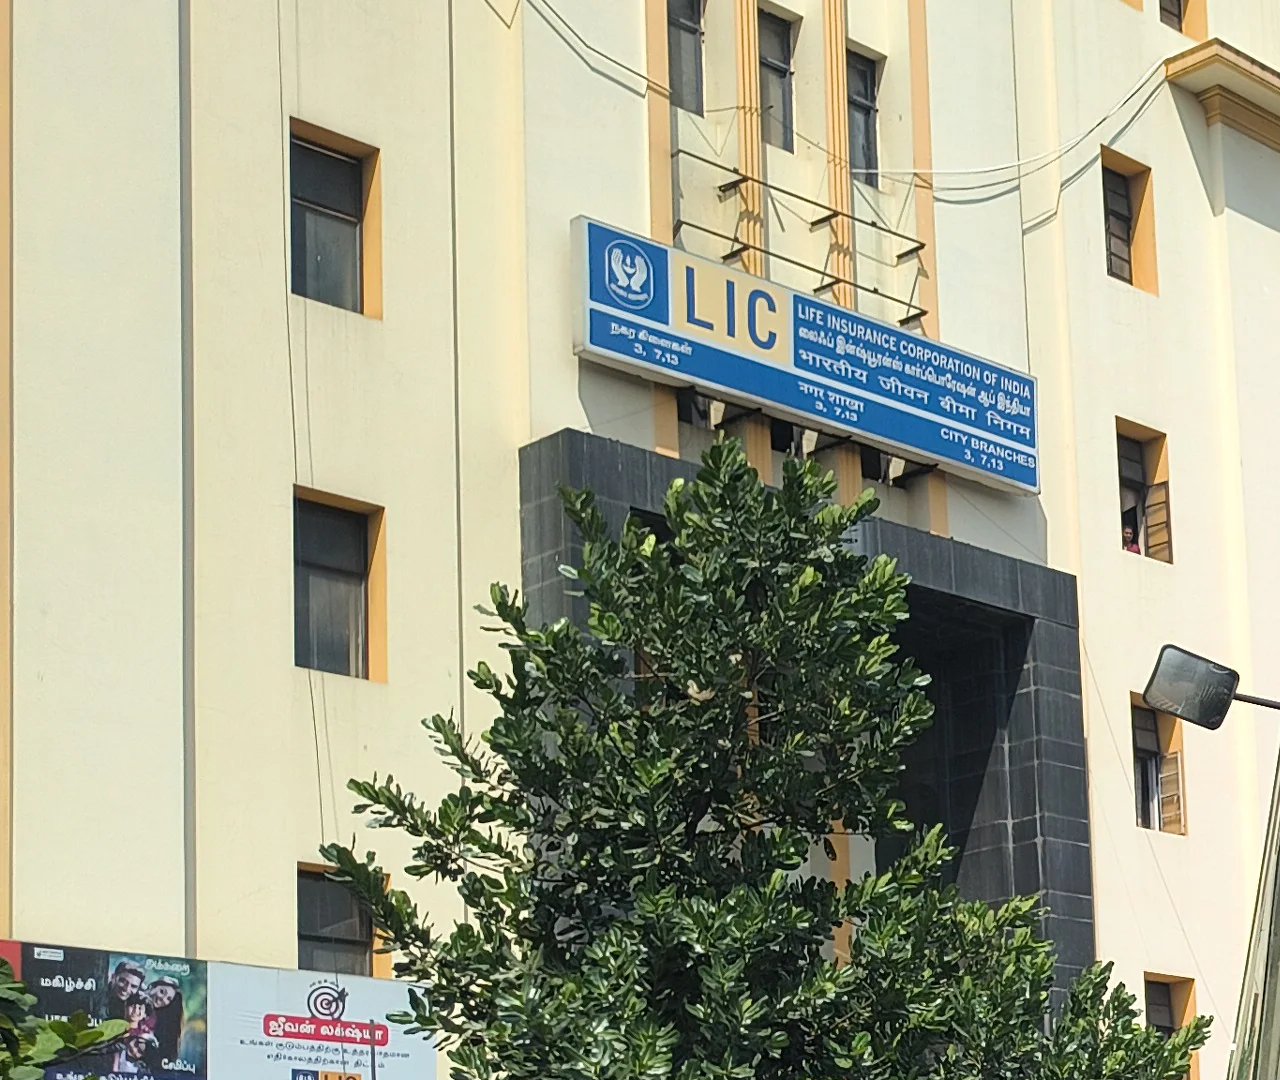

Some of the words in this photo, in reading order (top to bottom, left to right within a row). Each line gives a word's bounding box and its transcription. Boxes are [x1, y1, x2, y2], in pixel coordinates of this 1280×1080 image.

[686, 265, 777, 350] LIC
[798, 304, 824, 325] LIFE
[827, 313, 897, 351] INSURANCE
[900, 340, 981, 381] CORPORATION
[983, 370, 998, 387] OF
[1000, 377, 1031, 400] INDIA
[798, 349, 869, 384] भारतीय
[877, 374, 931, 405] जीवन
[939, 394, 978, 421] बीमा
[985, 410, 1032, 440] निगम
[997, 392, 1031, 417] இந்தியா
[940, 427, 969, 446] CITY
[970, 437, 1036, 469] BRANCHES
[41, 975, 96, 992] மகிழ்ச்சி
[268, 1016, 315, 1037] ஜீவன்
